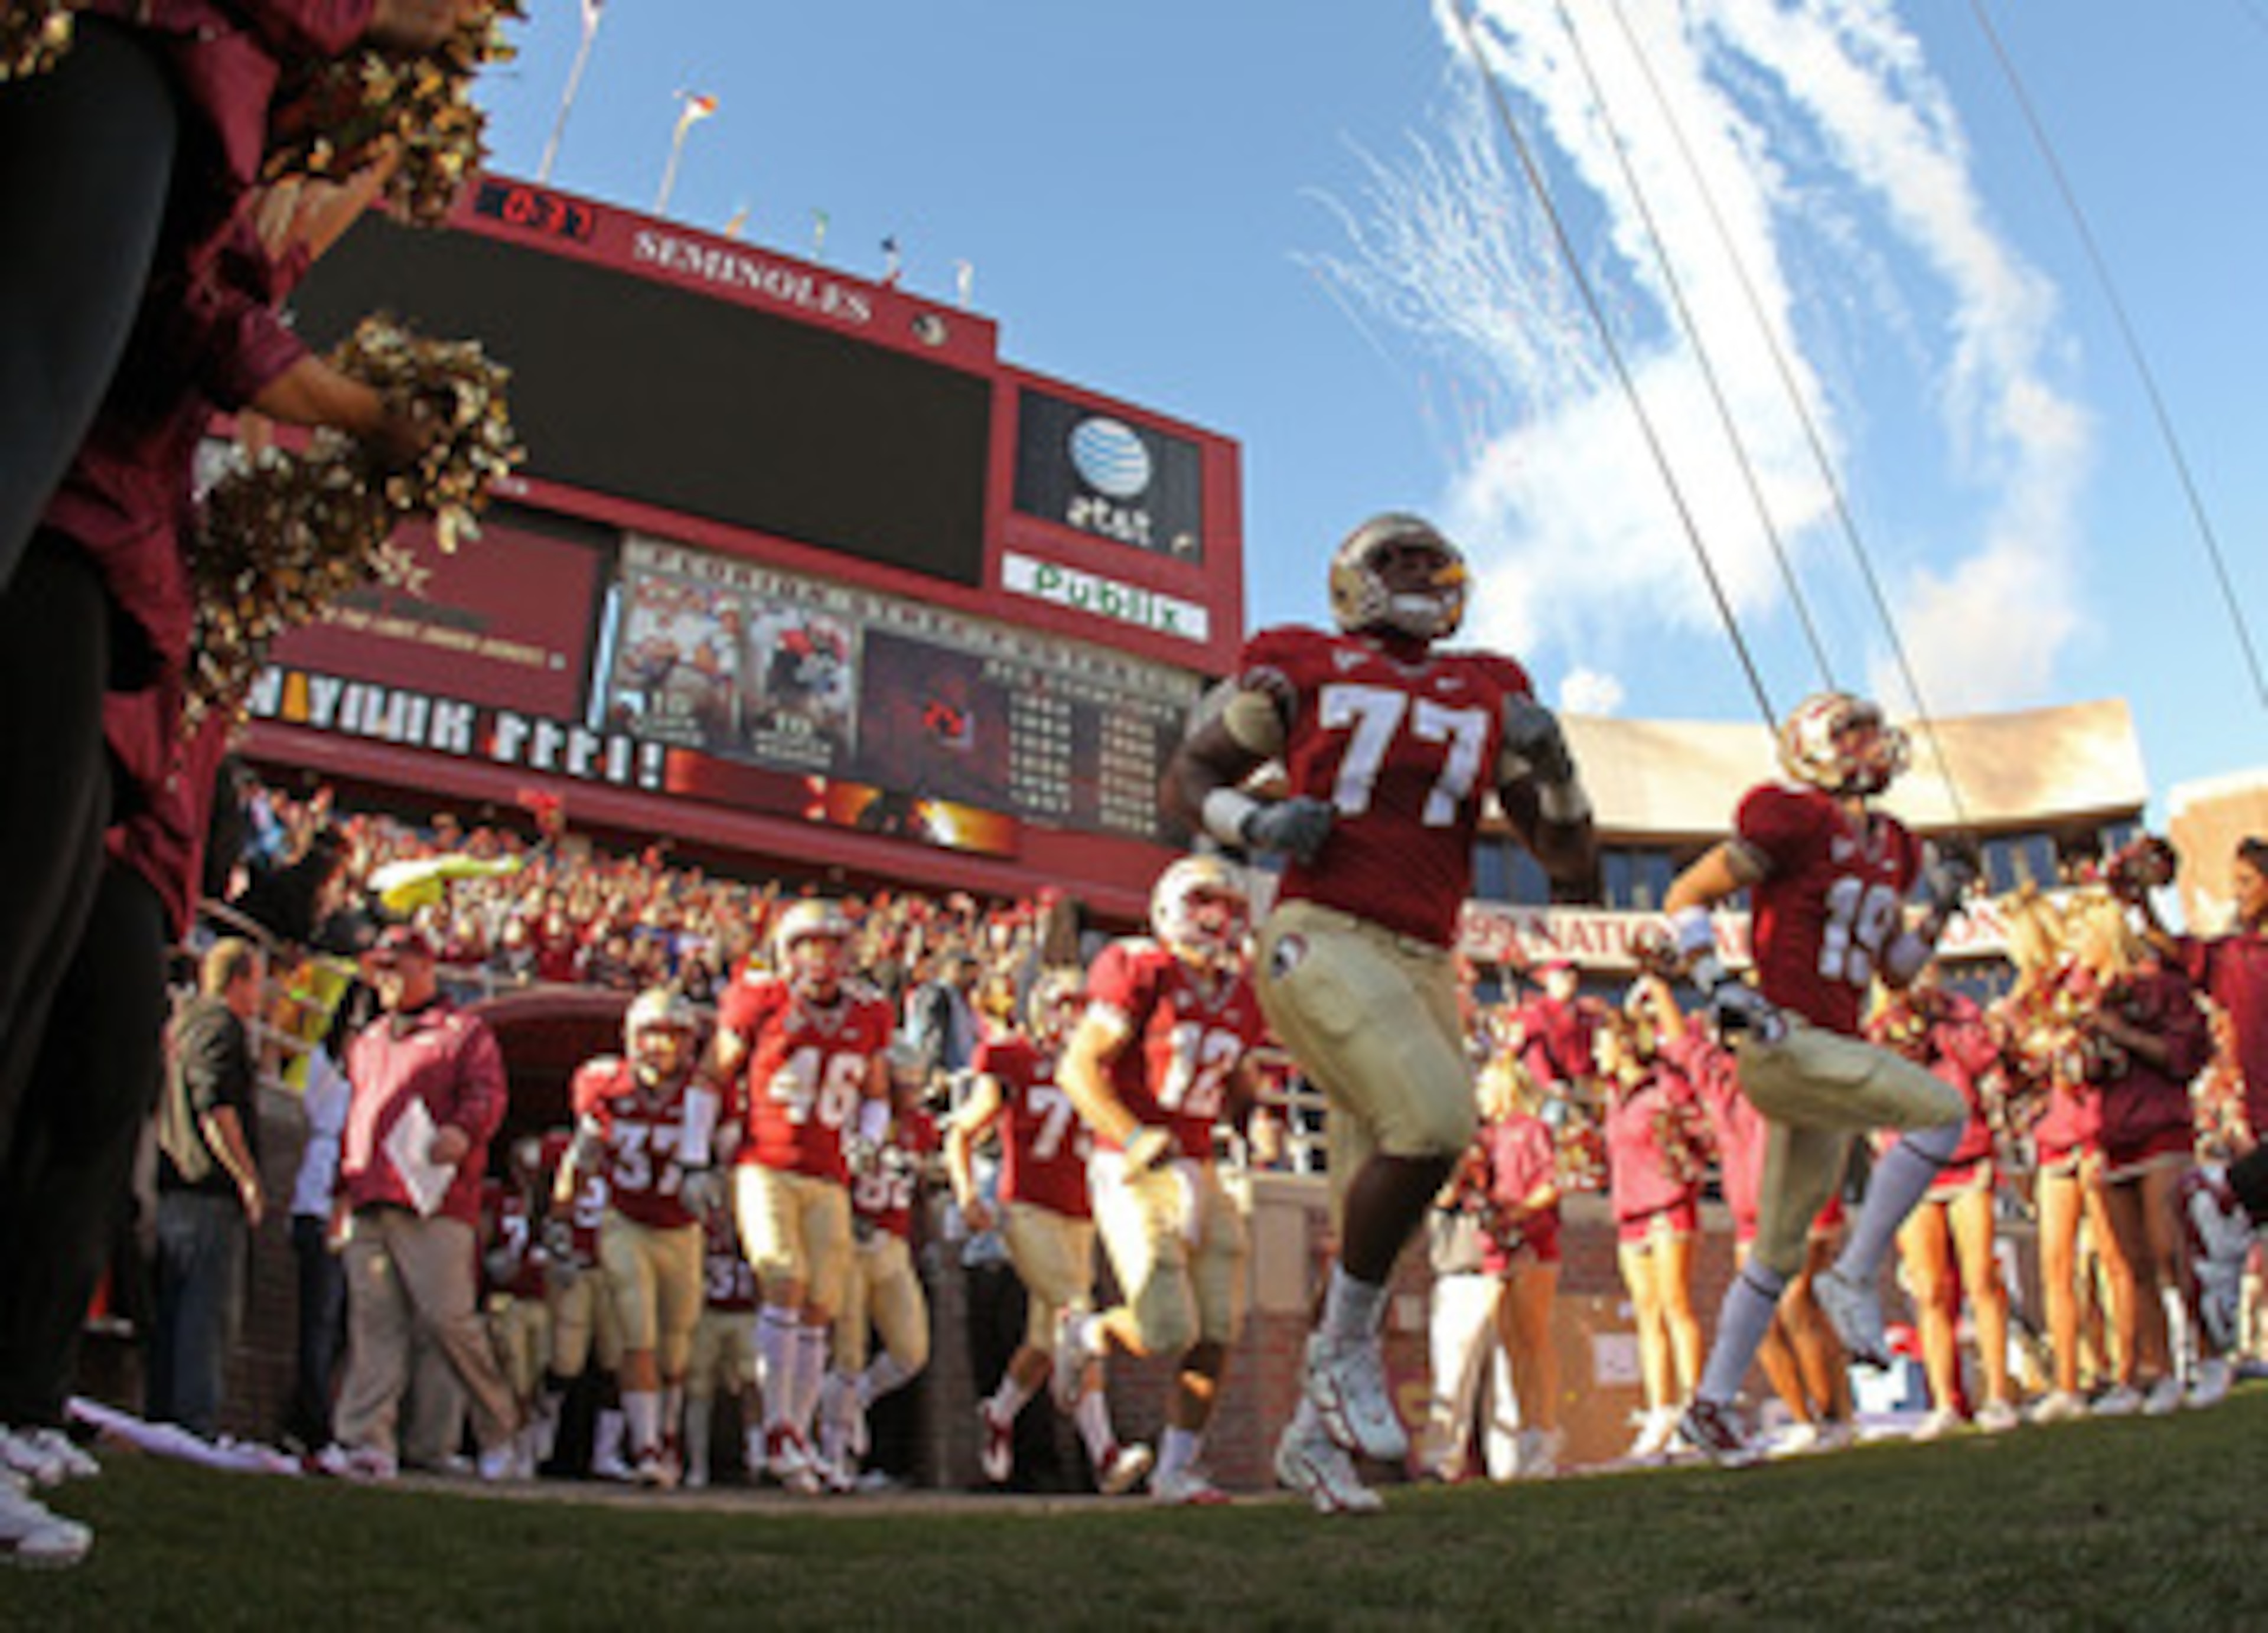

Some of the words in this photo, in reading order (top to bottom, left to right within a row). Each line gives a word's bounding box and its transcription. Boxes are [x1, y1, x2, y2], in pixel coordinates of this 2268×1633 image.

[633, 229, 872, 324] SEMINOLES
[1035, 562, 1182, 632] Publix
[1318, 682, 1489, 827] 77
[767, 1043, 867, 1132] 46
[1156, 1019, 1244, 1117] 12
